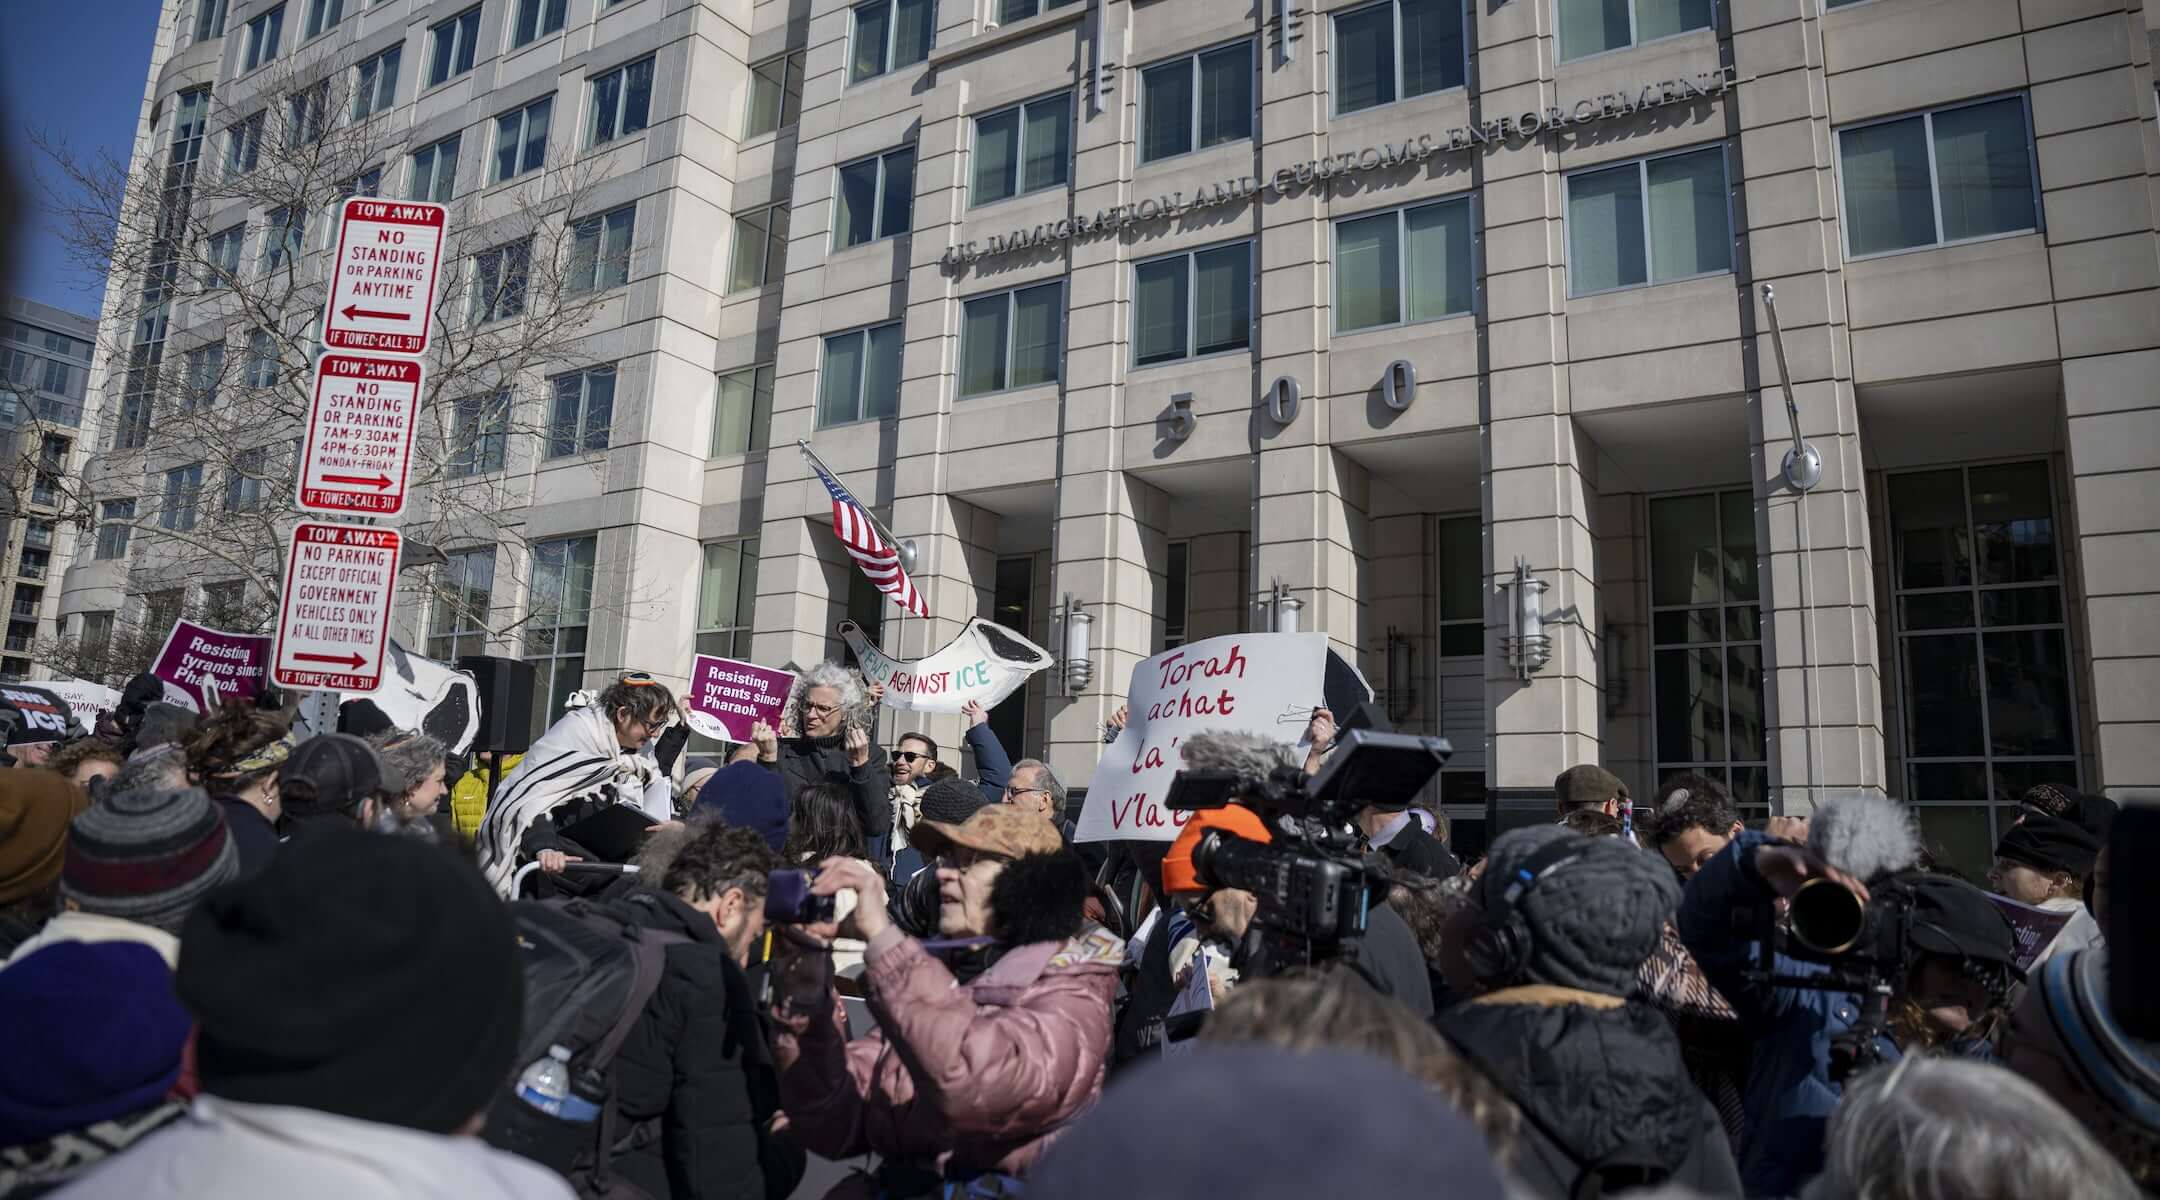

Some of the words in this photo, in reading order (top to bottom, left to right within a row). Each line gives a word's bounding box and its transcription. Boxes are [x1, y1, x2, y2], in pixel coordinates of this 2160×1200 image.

[986, 192, 1182, 255] IMMIGRATION
[1193, 176, 1260, 208] AND
[1271, 133, 1432, 193] CUSTOMS
[1445, 65, 1735, 151] ENFORCEMENT
[357, 203, 387, 217] TOW
[391, 207, 435, 221] AWAY
[378, 230, 404, 245] NO
[352, 246, 425, 265] STANDING
[347, 265, 365, 276] OR
[367, 265, 423, 281] PARKING
[352, 282, 414, 299] ANYTIME
[330, 330, 342, 343] IF
[406, 336, 420, 350] 311
[332, 360, 361, 374] TOW
[366, 363, 408, 378] AWAY
[356, 382, 379, 396] NO
[330, 394, 402, 412] STANDING
[323, 410, 341, 424] OR
[346, 412, 403, 428] PARKING
[319, 456, 394, 471] MONDAY-FRIDAY
[306, 490, 317, 503] IF
[381, 496, 395, 509] 311
[308, 527, 339, 542] TOW
[343, 531, 386, 546] AWAY
[304, 546, 322, 561] NO
[328, 549, 385, 566] PARKING
[300, 564, 336, 581] EXCEPT
[339, 568, 382, 585] OFFICIAL
[299, 585, 377, 605] GOVERNMENT
[295, 604, 345, 622] VEHICLES
[349, 608, 377, 625] ONLY
[292, 624, 304, 637] AT
[304, 625, 319, 640] ALL
[322, 626, 349, 642] OTHER
[350, 628, 374, 645] TIMES
[189, 636, 250, 662] Resisting
[181, 653, 234, 675] tyrants
[236, 663, 263, 677] since
[1159, 645, 1247, 690] Torah
[173, 666, 239, 692] Phaaoh.
[280, 671, 292, 683] IF
[358, 677, 373, 689] 311
[708, 666, 769, 691] Resisting
[888, 670, 950, 694] AGAINST
[956, 660, 991, 691] ICE
[705, 682, 751, 700] tyrants
[753, 692, 781, 706] since
[702, 695, 759, 717] Pharaoh.
[1148, 689, 1234, 721] achat
[20, 708, 67, 737] ICE
